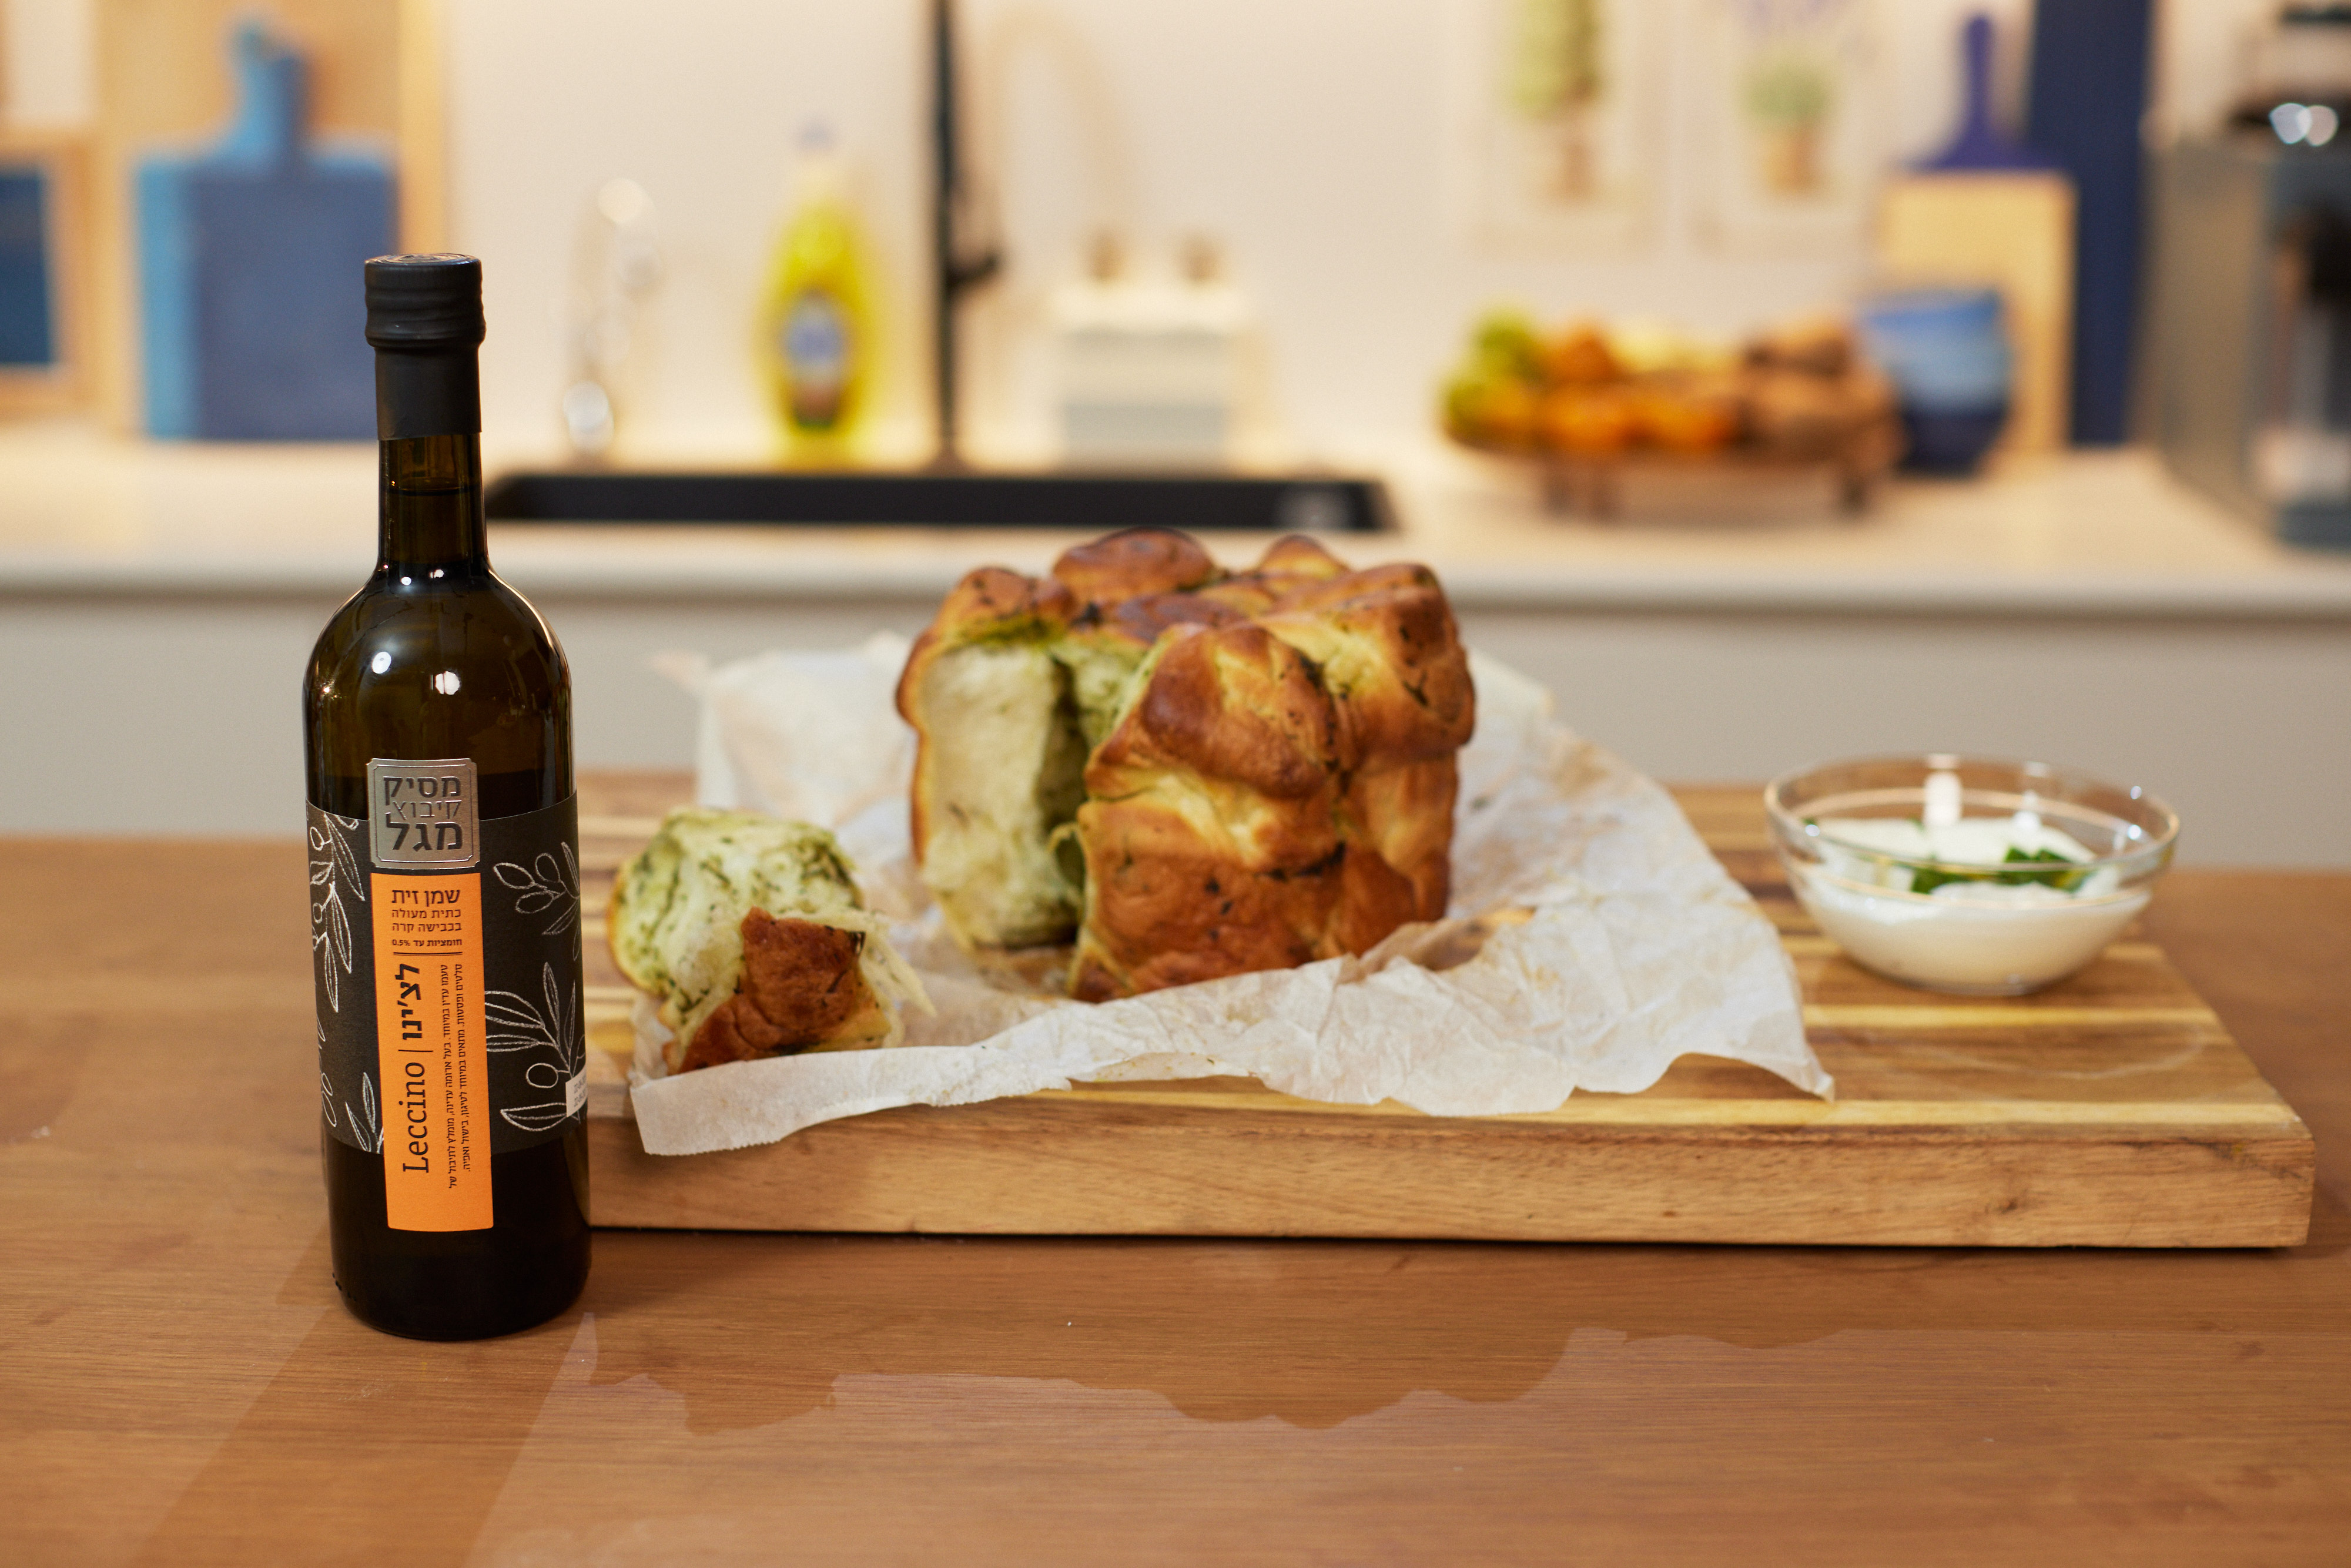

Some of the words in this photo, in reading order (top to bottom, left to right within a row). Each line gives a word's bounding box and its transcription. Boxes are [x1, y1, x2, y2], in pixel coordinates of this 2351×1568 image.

[383, 776, 461, 806] מסיק
[384, 812, 463, 852] מגל
[391, 889, 418, 904] זית
[424, 889, 461, 907] שמן
[391, 908, 427, 918] מעולה
[431, 909, 461, 918] כתית
[392, 923, 414, 933] קרה
[418, 923, 462, 932] בכבישה
[441, 964, 449, 986] טעמו
[442, 989, 450, 1006] עדין
[443, 1009, 451, 1040] במיוחד.
[443, 1042, 451, 1059] בעל
[454, 964, 463, 990] סלטים
[461, 1120, 469, 1144] בישול
[446, 1090, 455, 1115] עדינה,
[398, 1063, 429, 1173] Leccino
[447, 1118, 456, 1144] מומלץ
[447, 1145, 456, 1174] לתיבול
[449, 1176, 457, 1188] של
